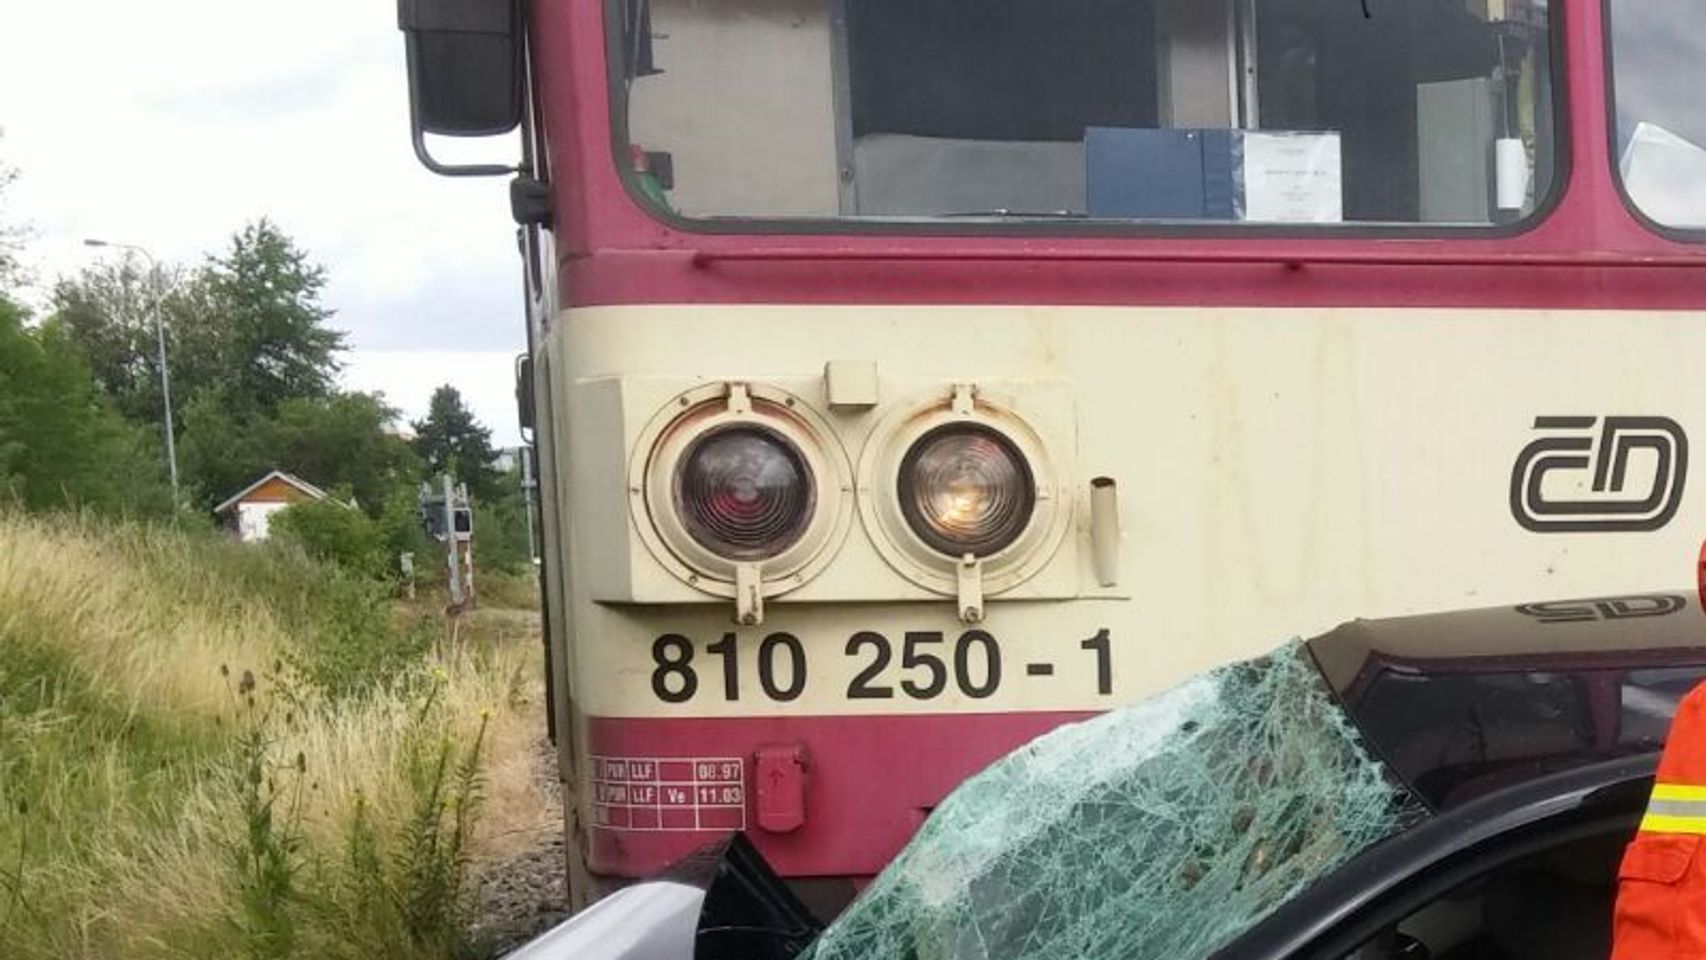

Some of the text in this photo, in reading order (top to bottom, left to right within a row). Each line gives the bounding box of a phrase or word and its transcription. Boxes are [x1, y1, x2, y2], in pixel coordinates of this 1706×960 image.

[651, 631, 807, 703] 810
[631, 762, 653, 779] LLF
[632, 786, 654, 803] LLF
[700, 787, 743, 803] 11.03
